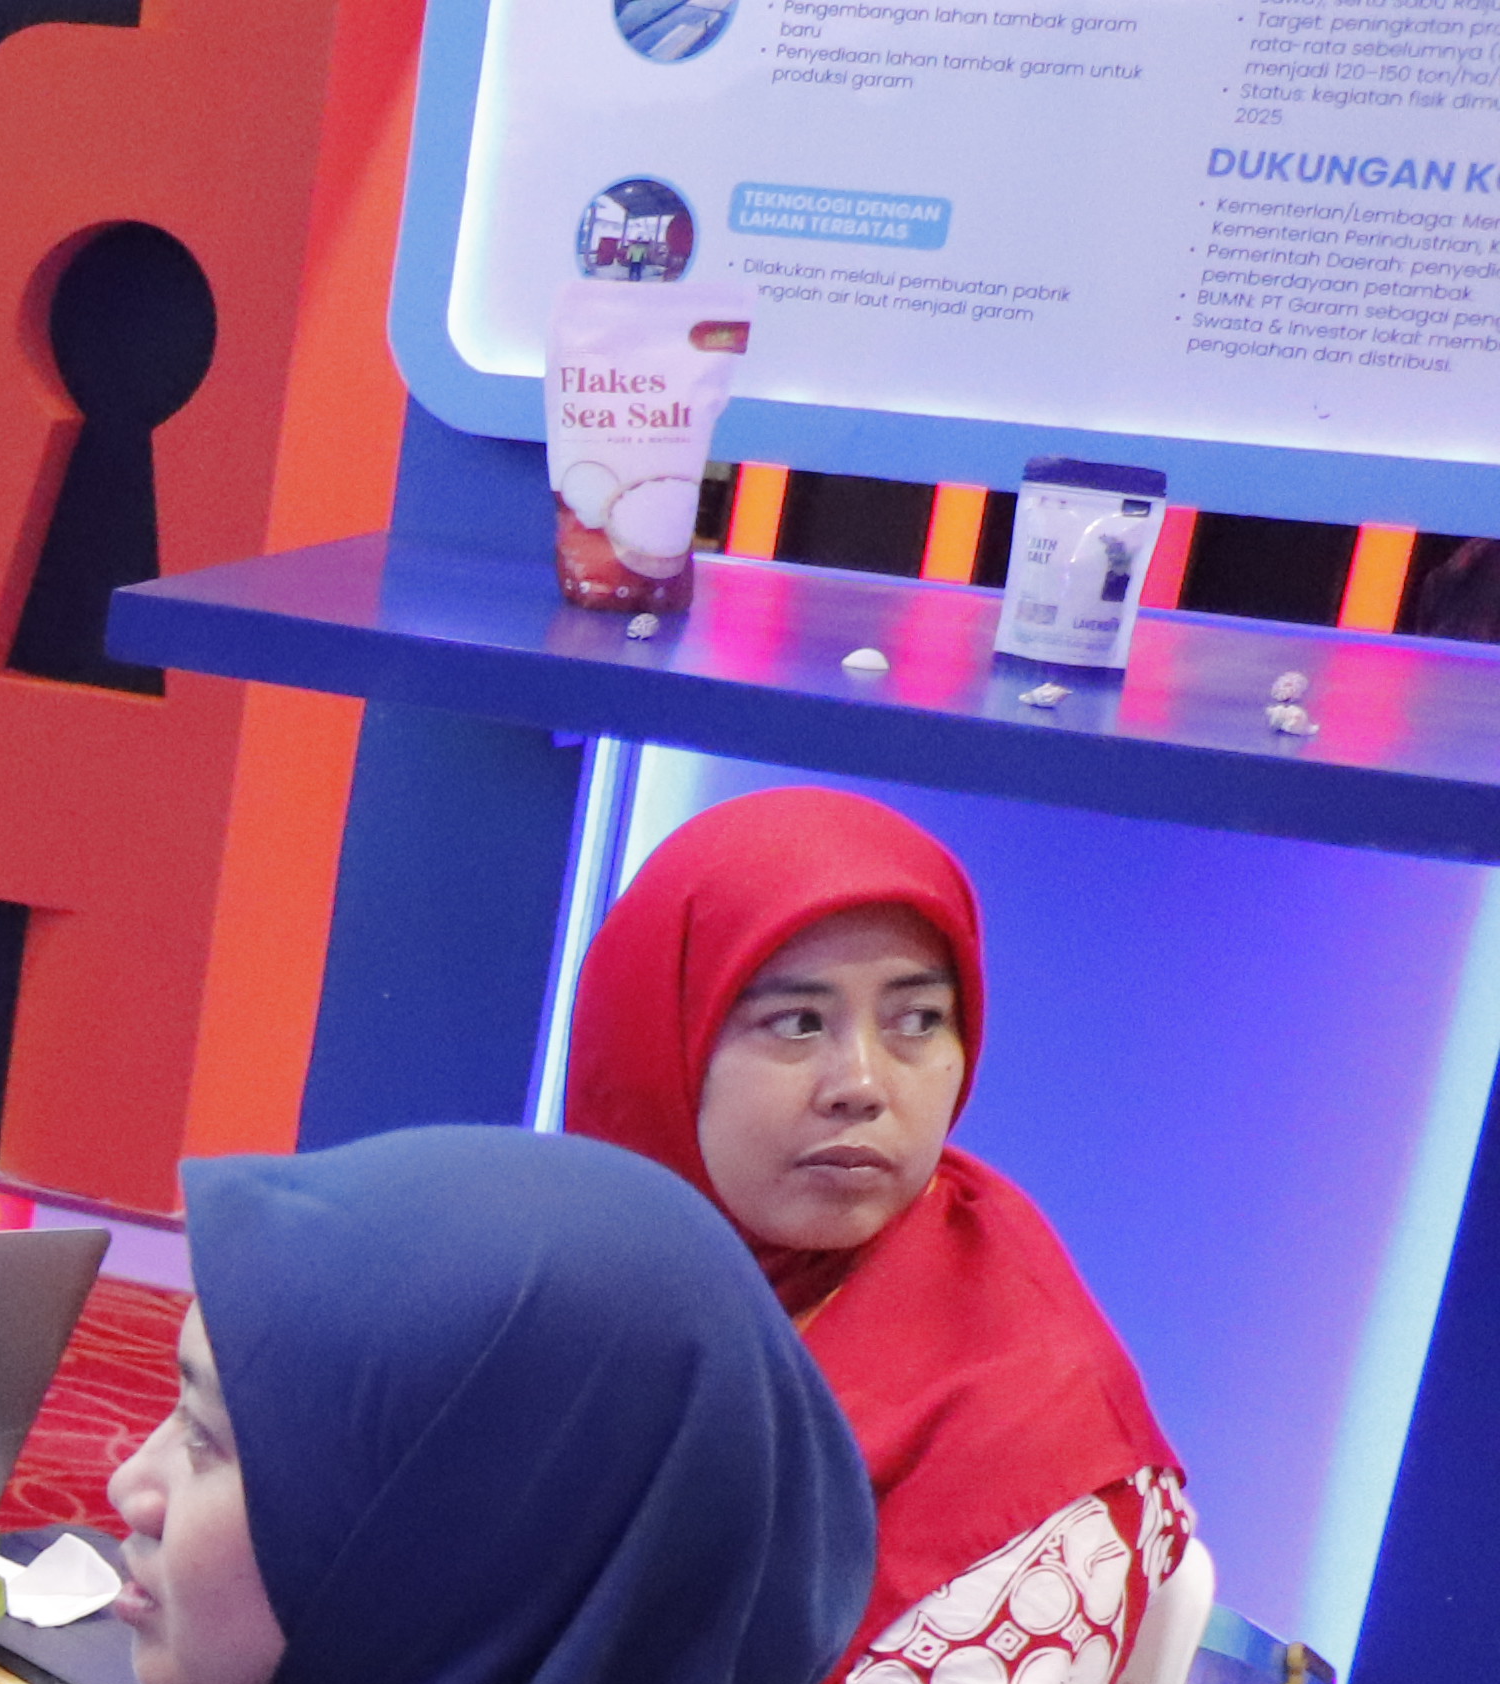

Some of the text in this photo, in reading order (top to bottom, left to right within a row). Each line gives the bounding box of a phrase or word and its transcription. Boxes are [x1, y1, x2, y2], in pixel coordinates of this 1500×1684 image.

[780, 21, 821, 40] baru
[783, 0, 1138, 35] Pengembangan lahan tambak garam
[1330, 16, 1464, 39] peningkatan
[775, 43, 1144, 80] Penyediaan lahan tambak garam untuk
[1250, 38, 1347, 56] rata-rata
[1351, 41, 1484, 64] sebelumnya
[771, 65, 914, 92] produksi garam
[1245, 61, 1329, 81] menjadi
[1311, 84, 1404, 109] kegiatan
[1408, 89, 1446, 108] fisik
[1233, 107, 1284, 127] 2025
[1206, 147, 1500, 194] DUKUNGAN K
[743, 190, 941, 223] TEKNOLOGI DENGAN
[739, 211, 909, 241] LAHAN TERBATAS
[1211, 220, 1340, 246] Kementerian
[1206, 243, 1322, 268] Pemerintah
[743, 258, 1071, 304] Dilakukan melalui pembuatan pabrik
[1201, 268, 1359, 294] pemberdayaan
[827, 289, 850, 305] air
[853, 289, 889, 309] laut
[893, 295, 968, 319] menjadi
[970, 304, 1035, 323] garam
[1261, 295, 1284, 310] PT
[1288, 298, 1359, 317] Garam
[1364, 303, 1450, 328] sebagai
[1192, 312, 1263, 334] Swasta
[1268, 318, 1284, 334] &
[1288, 319, 1367, 342] Investor
[1186, 337, 1308, 360] pengolahan
[1312, 346, 1353, 363] dan
[560, 366, 667, 394] Flakes
[561, 402, 693, 429] Sea Salt
